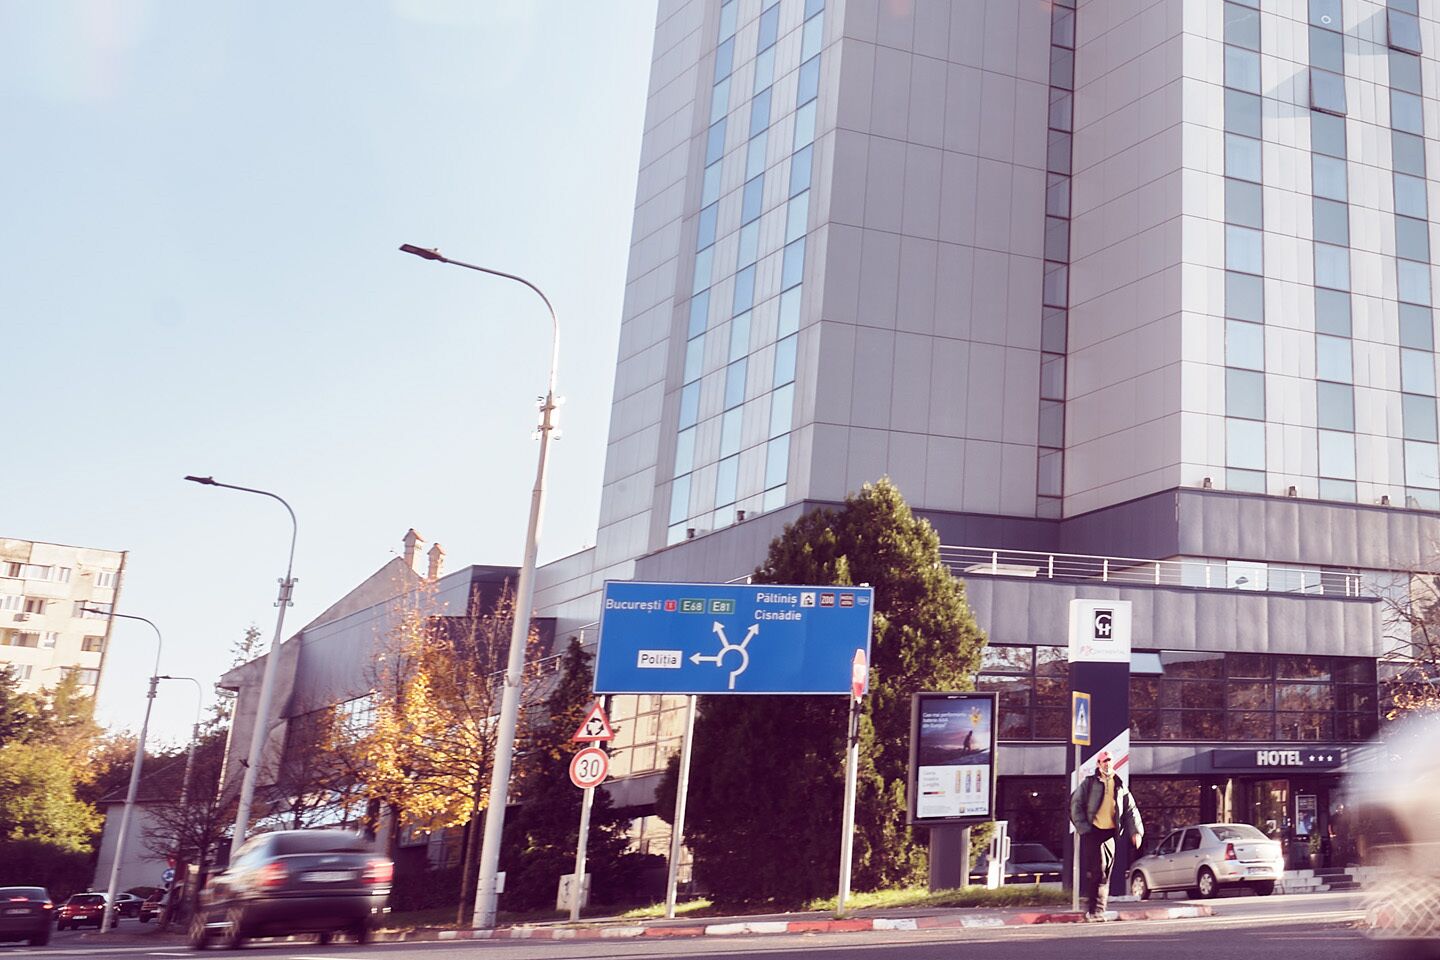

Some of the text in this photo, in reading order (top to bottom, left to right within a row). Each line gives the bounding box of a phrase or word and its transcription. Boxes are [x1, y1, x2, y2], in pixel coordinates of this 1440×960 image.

[605, 598, 662, 613] București
[683, 600, 703, 611] E68
[712, 601, 731, 613] E81
[756, 592, 798, 608] Păltiniș
[754, 609, 802, 621] Cisnădie
[641, 653, 677, 667] Poliția
[1256, 751, 1304, 766] HOTEL
[579, 759, 600, 778] 30
